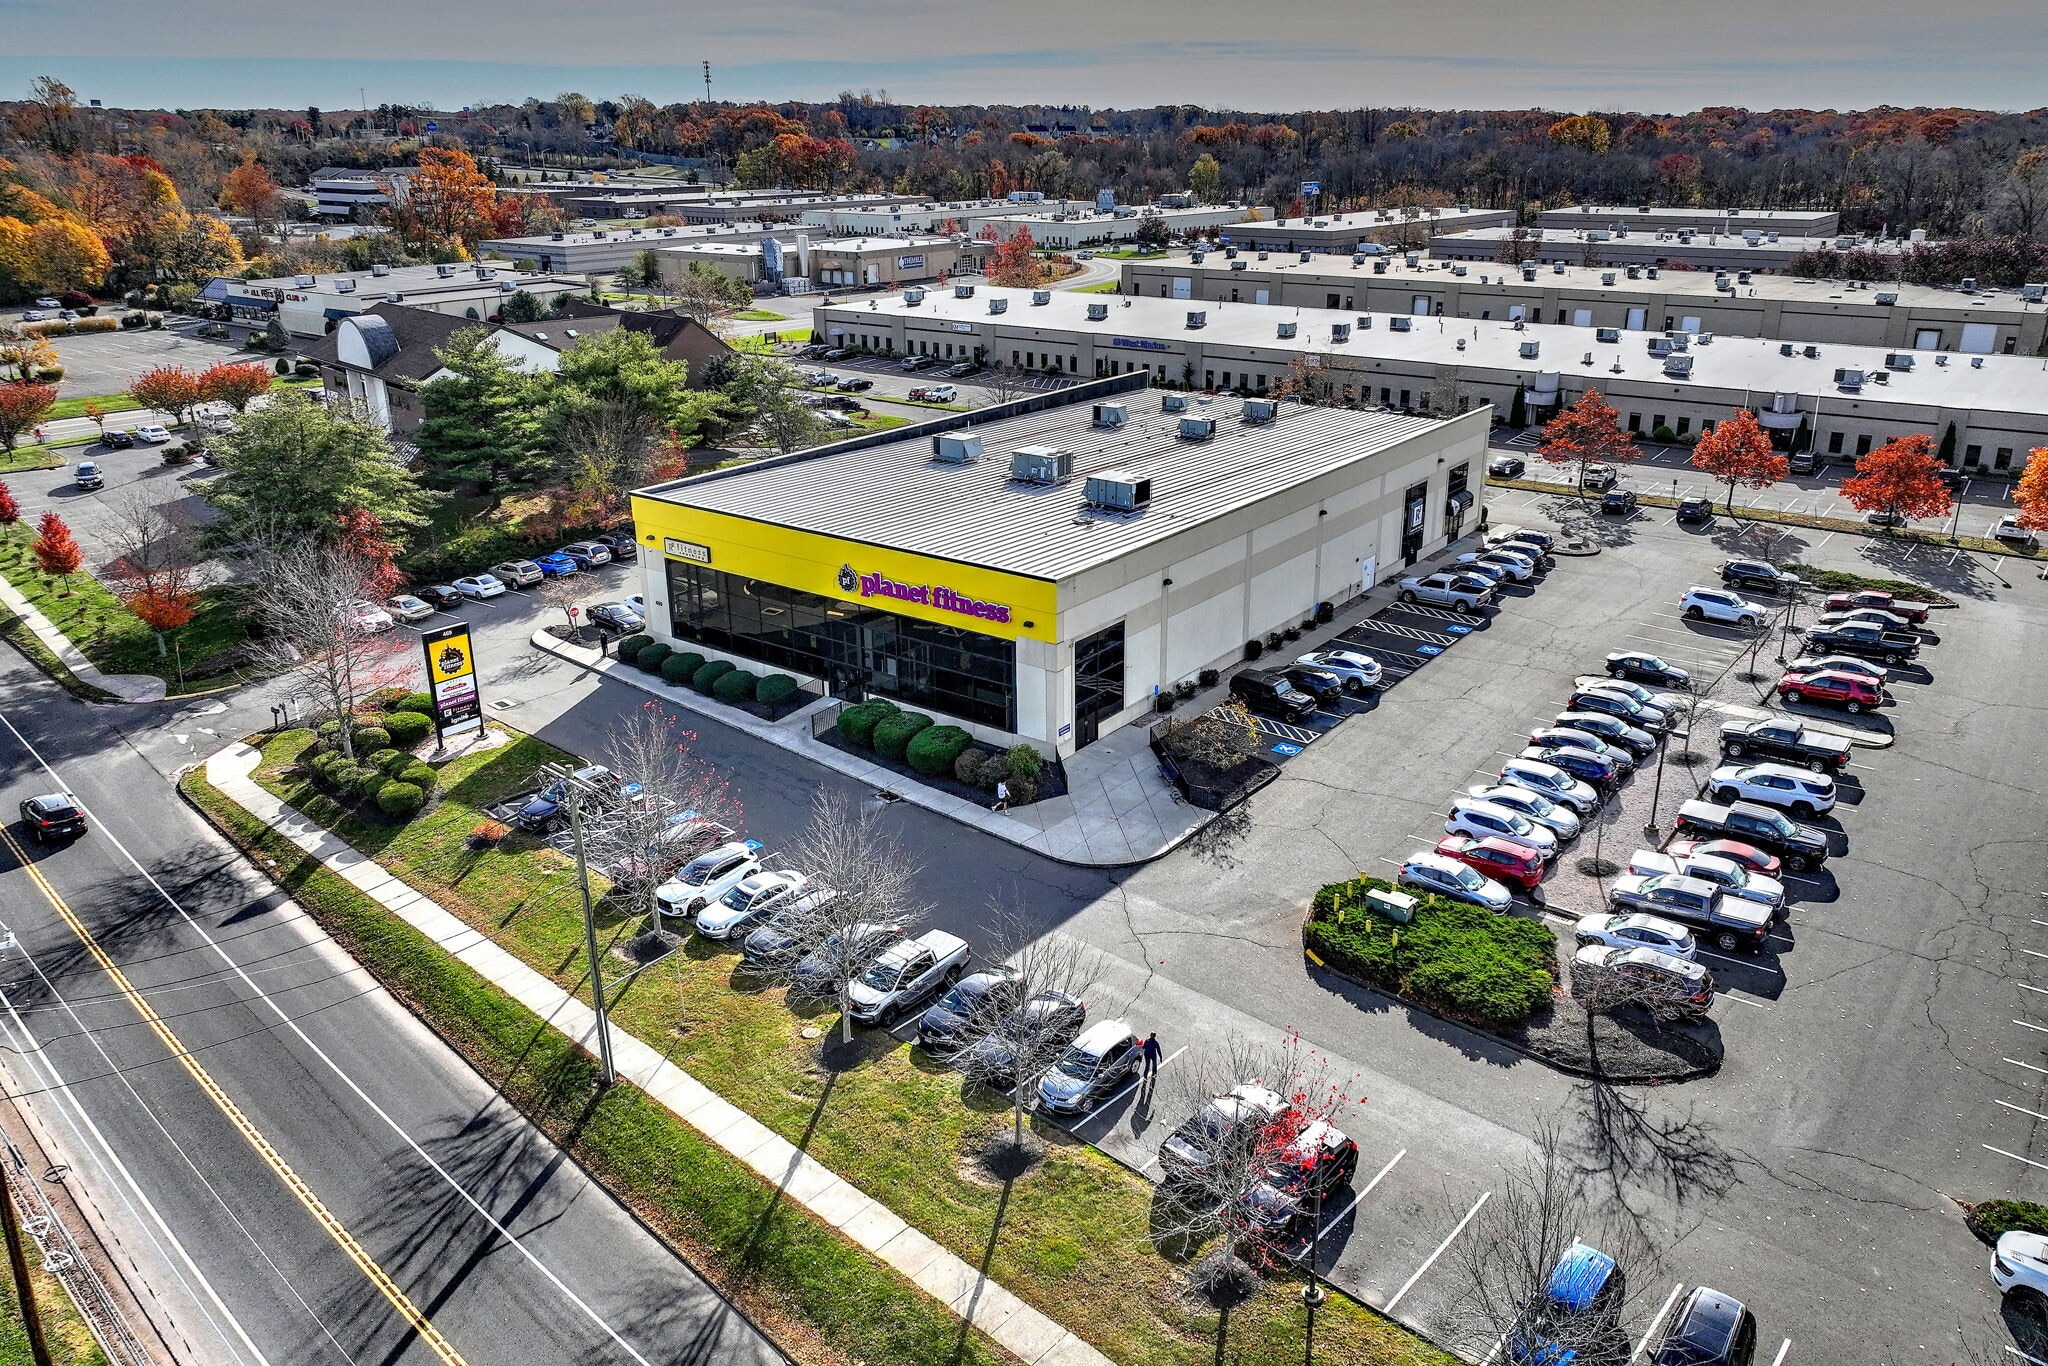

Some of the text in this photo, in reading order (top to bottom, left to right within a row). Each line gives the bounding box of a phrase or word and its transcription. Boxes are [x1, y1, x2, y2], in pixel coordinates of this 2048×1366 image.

[1121, 338, 1138, 348] West
[677, 544, 706, 556] fitness
[861, 572, 1012, 623] planet fitness
[440, 694, 475, 708] planet fitness
